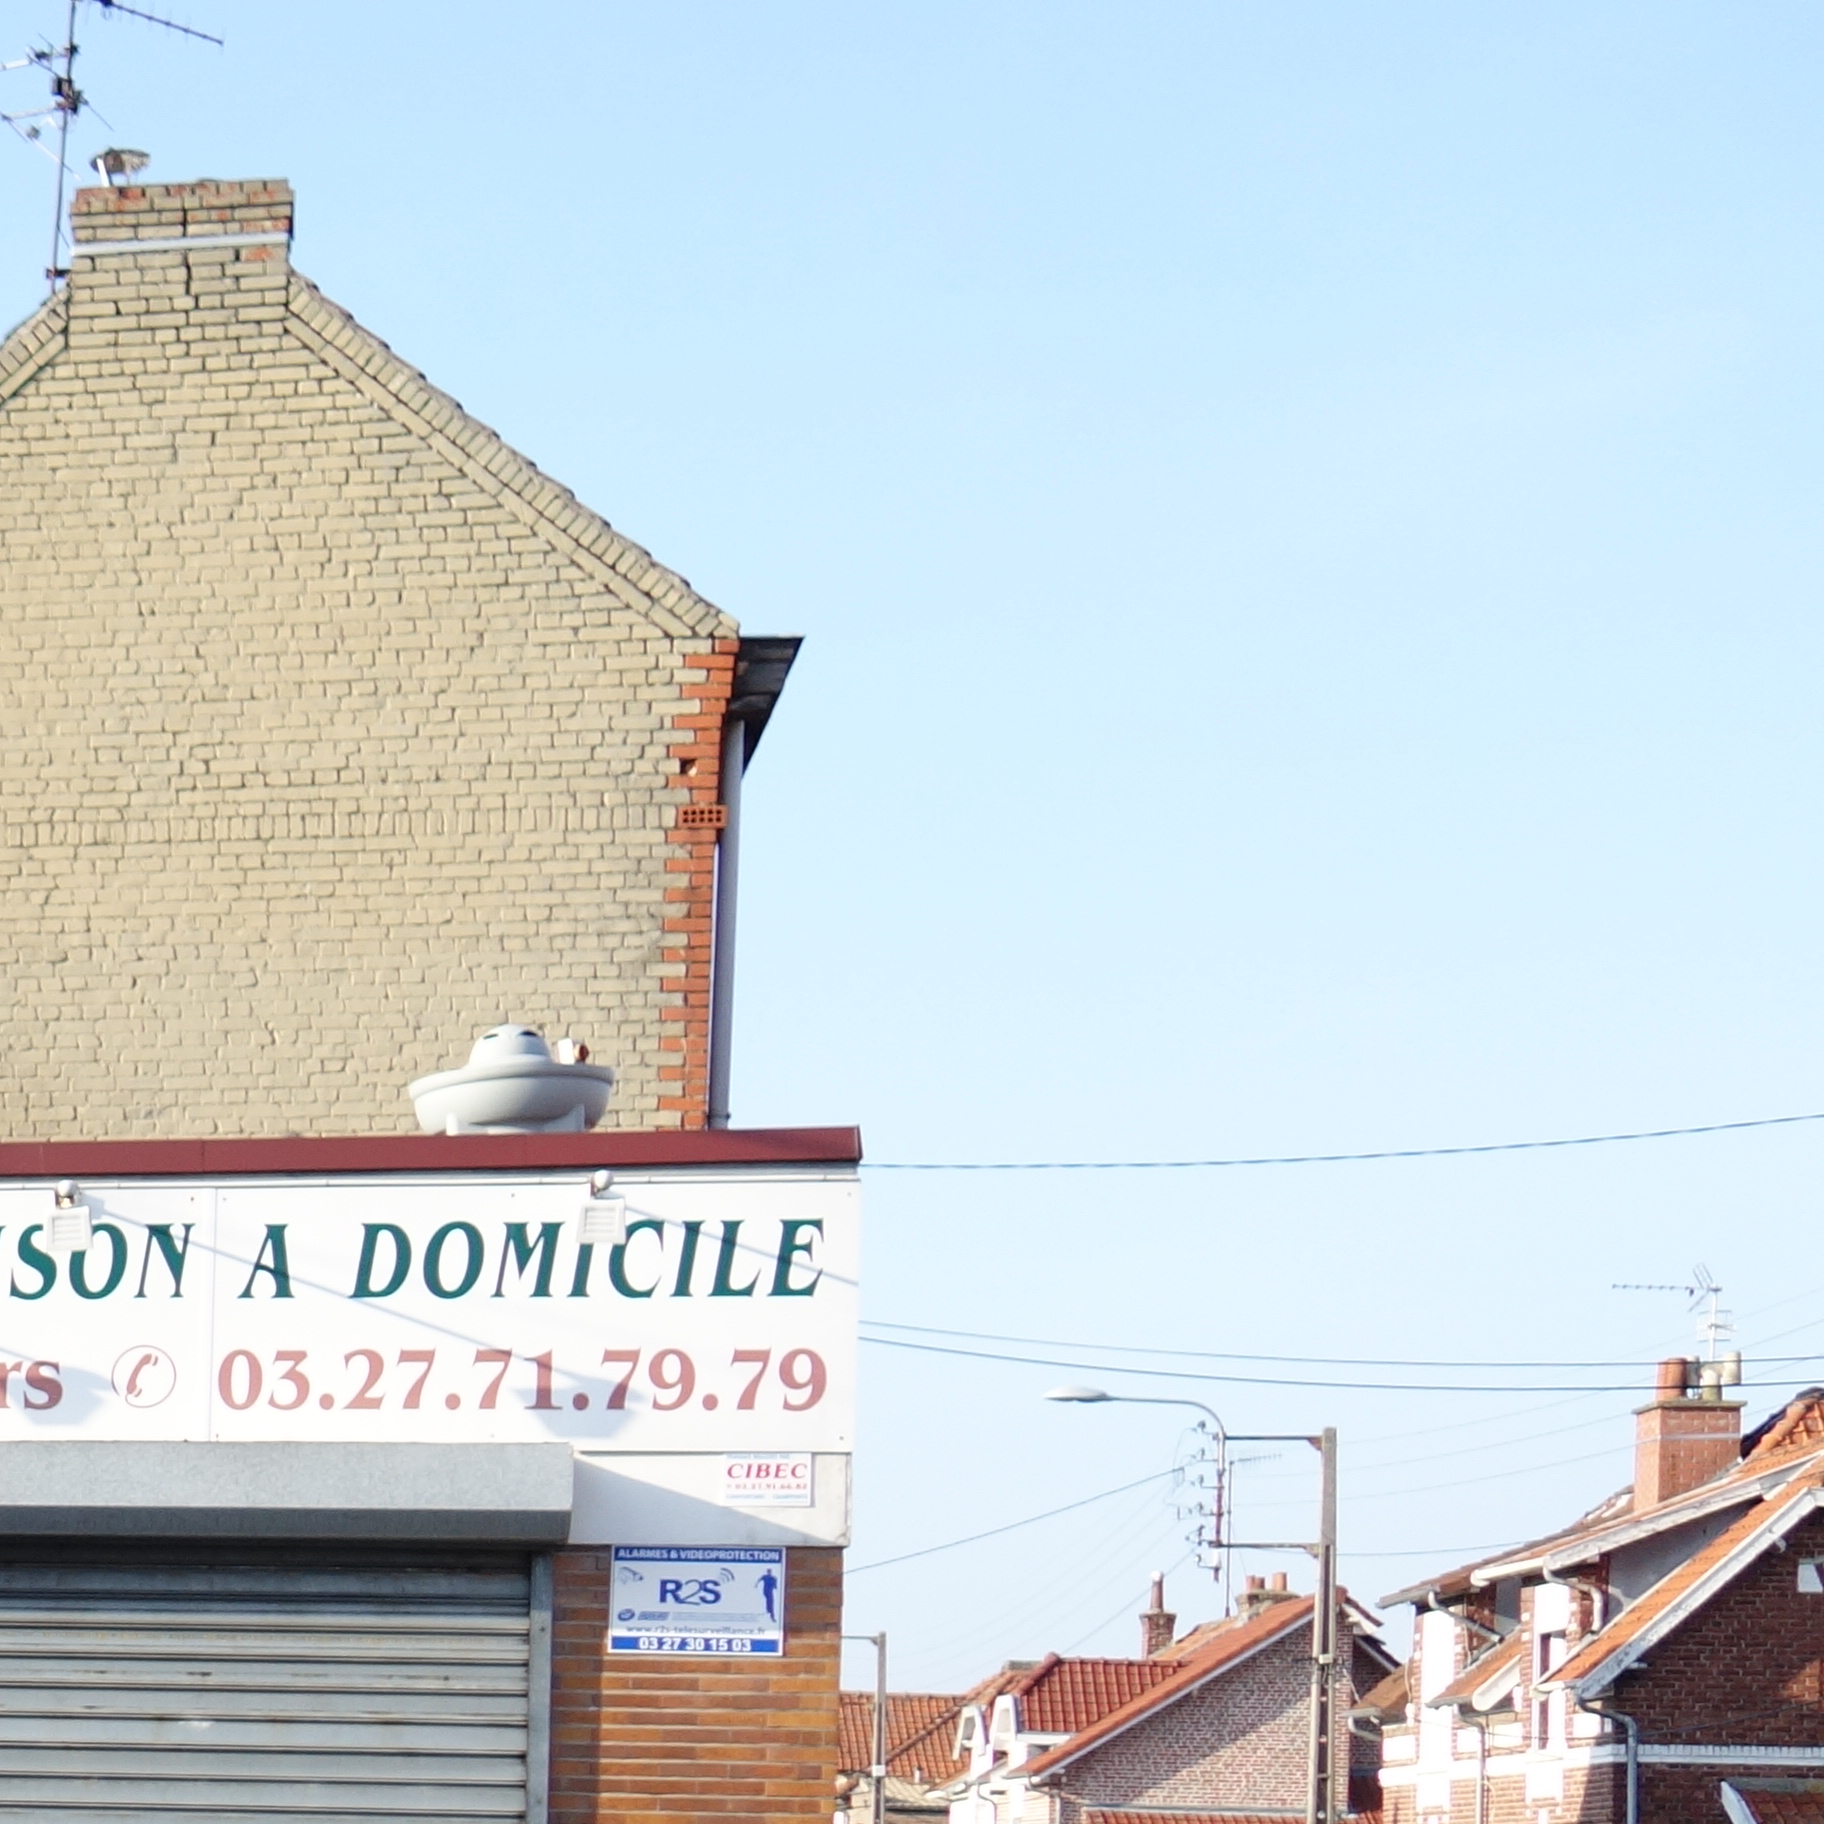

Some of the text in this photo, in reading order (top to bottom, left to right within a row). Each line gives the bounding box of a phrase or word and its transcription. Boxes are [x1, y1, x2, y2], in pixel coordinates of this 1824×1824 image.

[238, 1223, 295, 1300] A
[350, 1218, 825, 1300] DOMICILE
[216, 1347, 829, 1413] 03.27.71.79.79
[727, 1462, 808, 1479] CIBEC
[618, 1549, 780, 1561] ALARMES & VIDEOPROTECTION
[659, 1578, 722, 1606] R2S
[639, 1637, 752, 1652] 03 27 30 15 03
